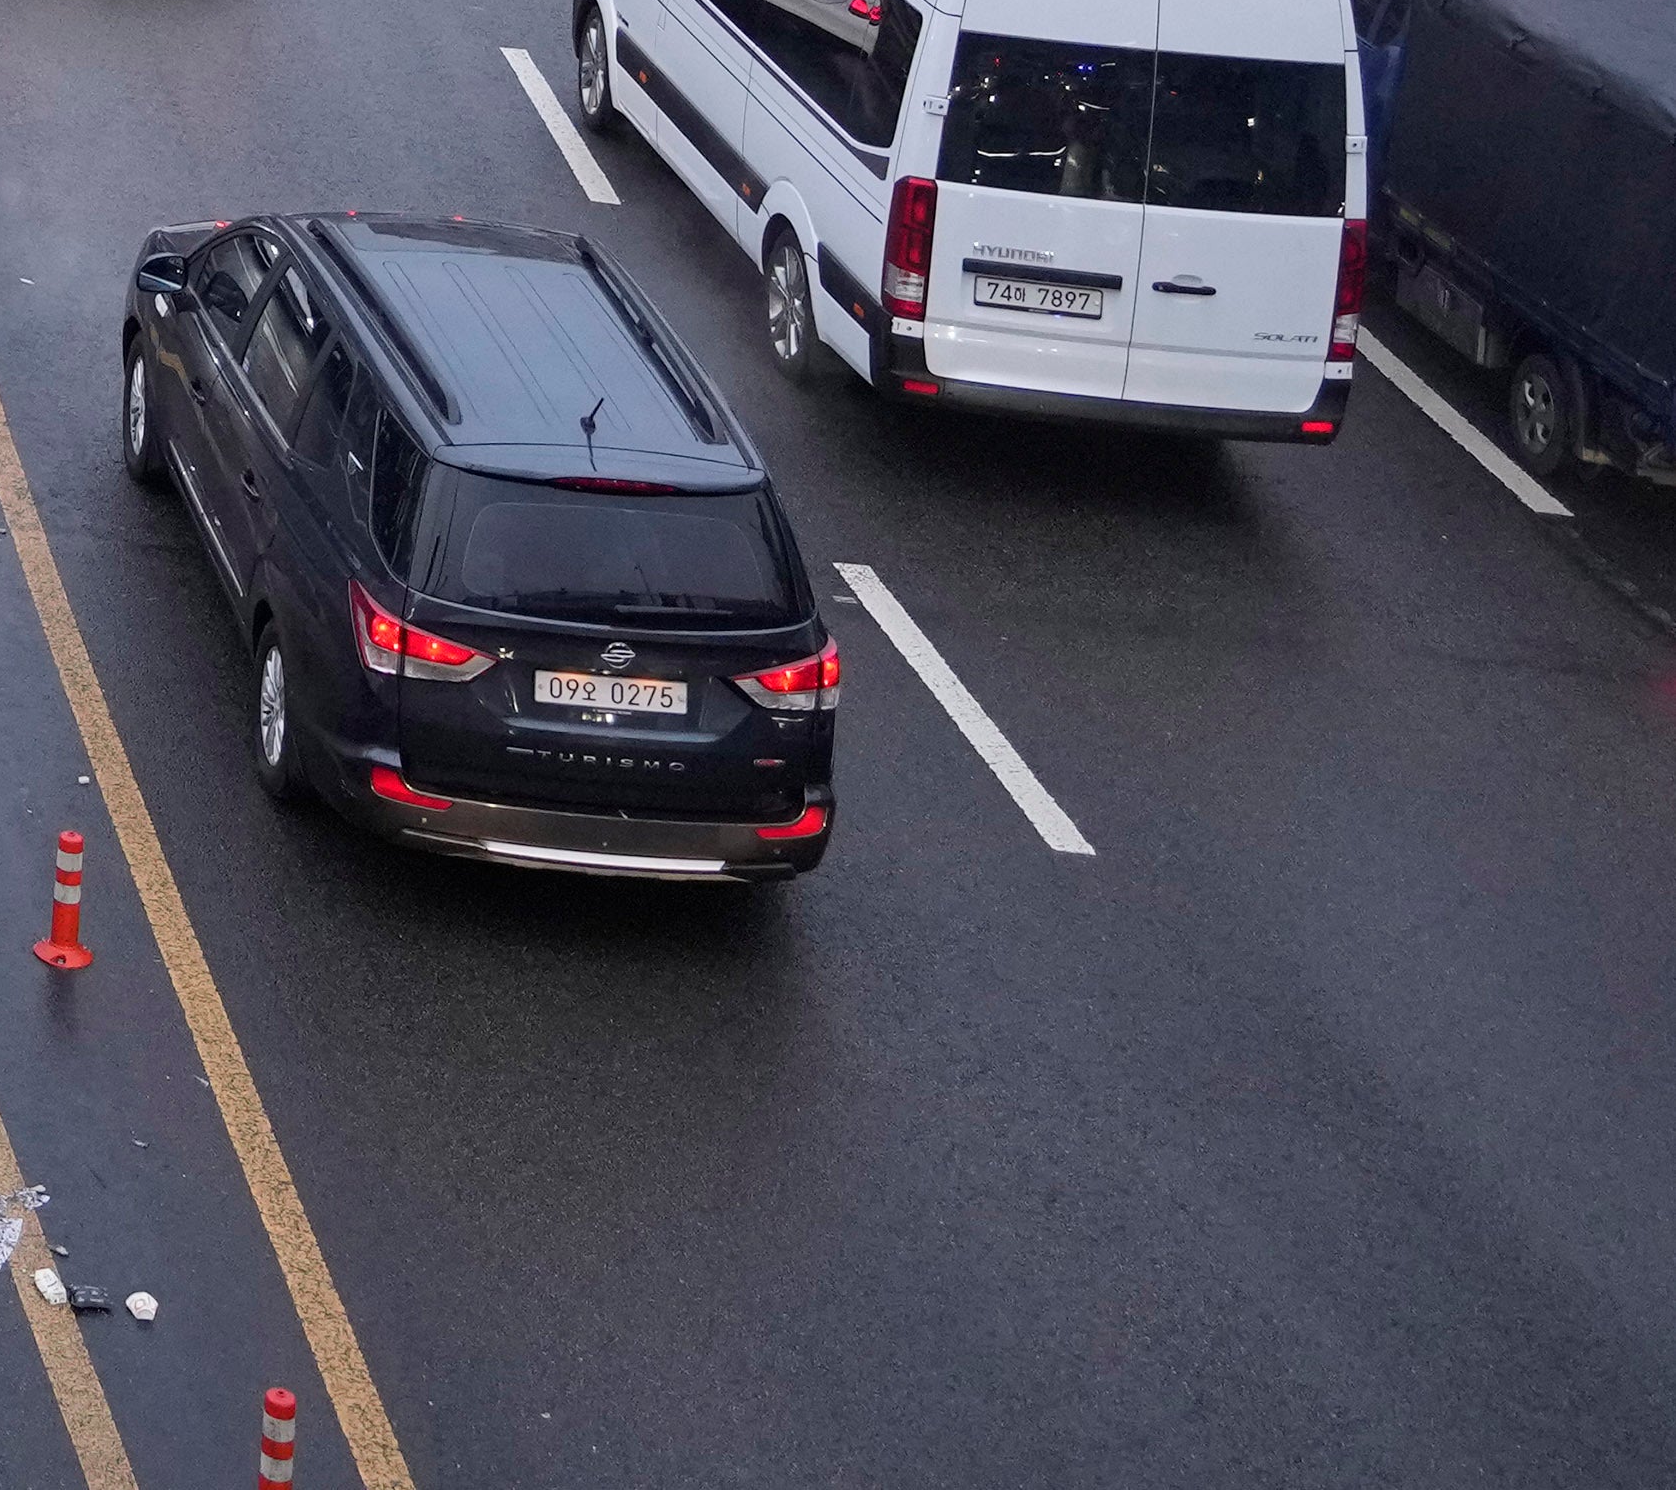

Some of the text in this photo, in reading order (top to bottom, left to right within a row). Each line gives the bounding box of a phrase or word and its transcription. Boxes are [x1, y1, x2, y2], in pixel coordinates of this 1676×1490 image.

[1038, 287, 1090, 311] 7897
[548, 676, 674, 708] 09오 0275
[536, 749, 685, 771] TURISMO
